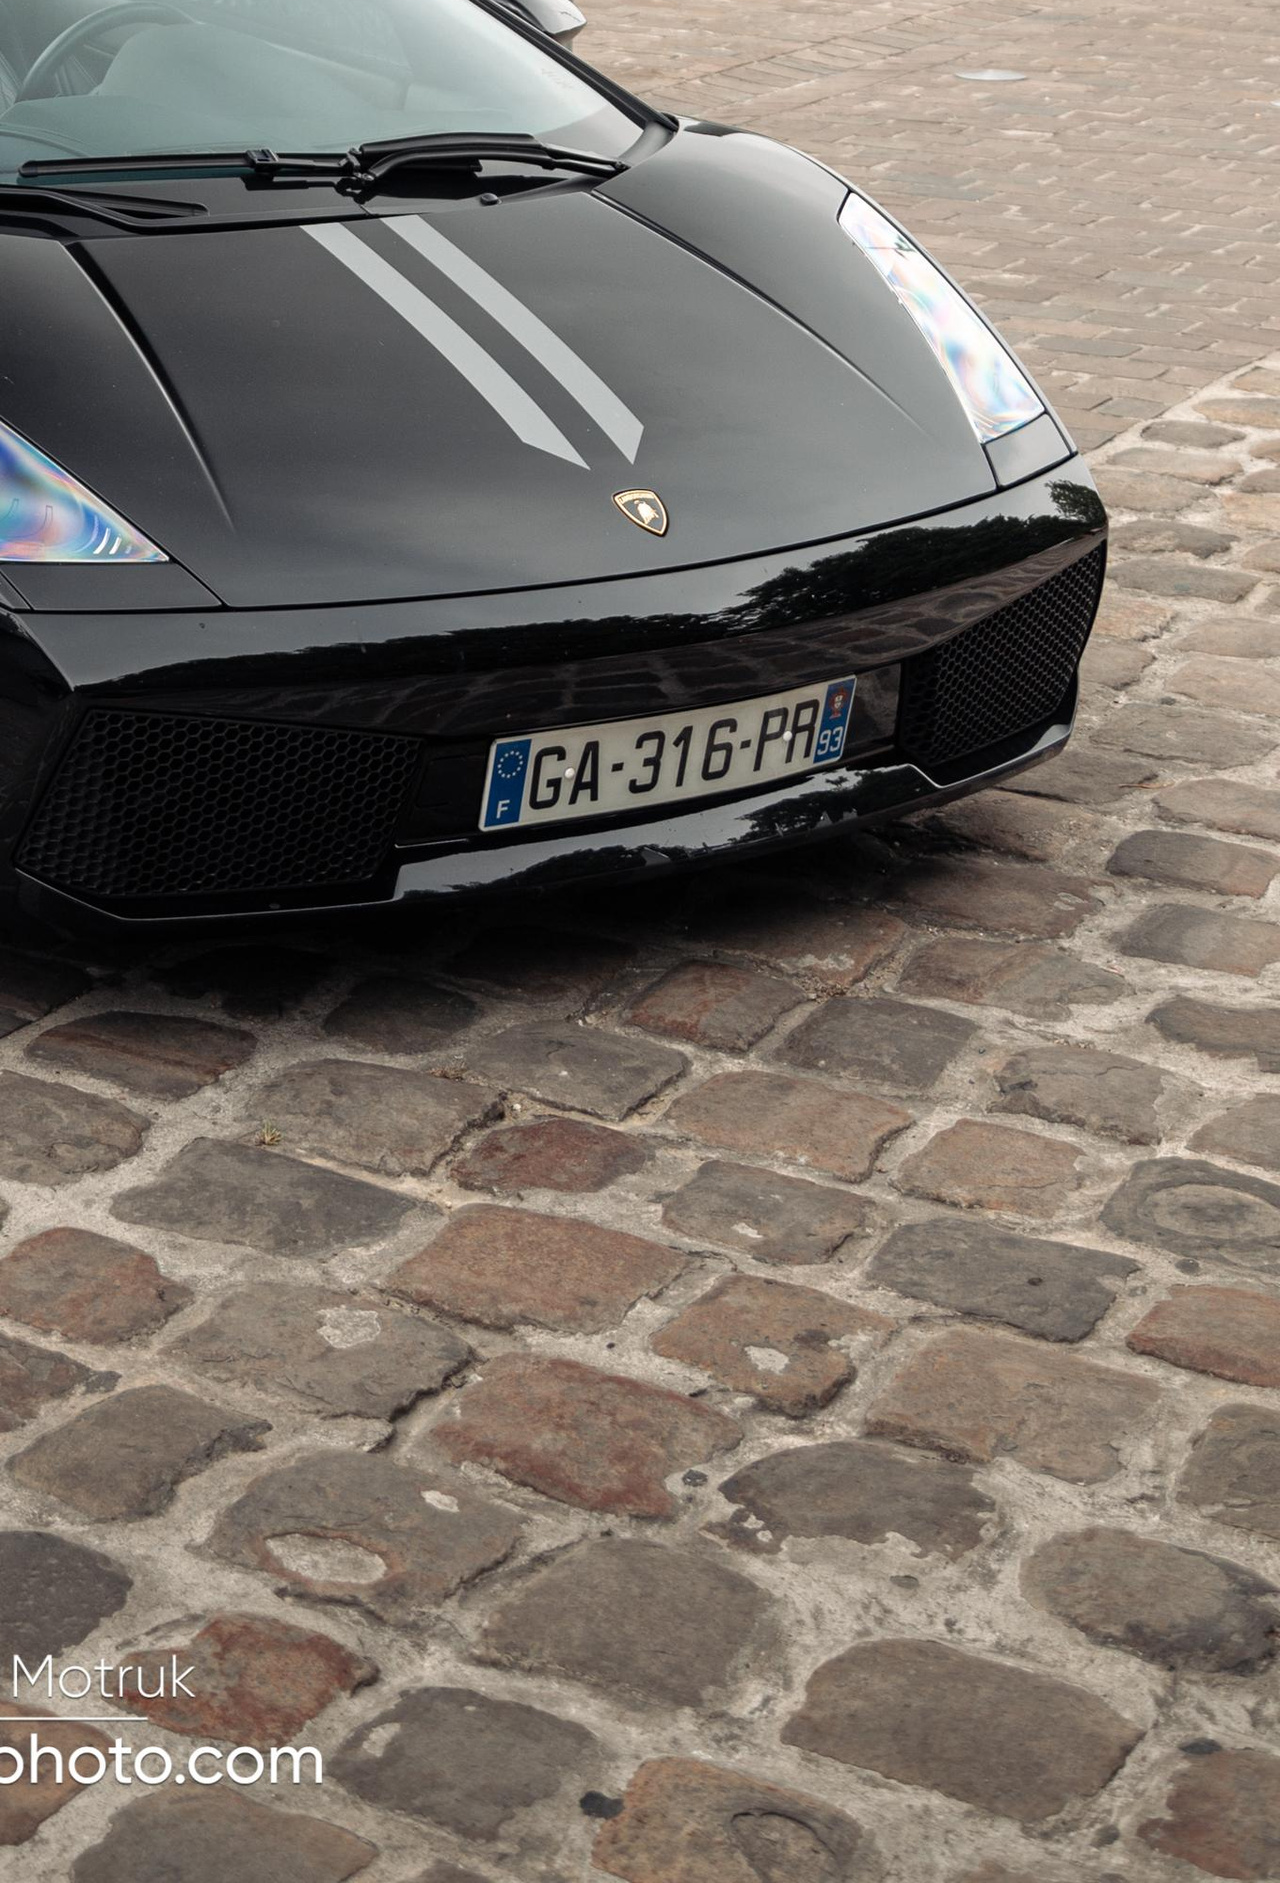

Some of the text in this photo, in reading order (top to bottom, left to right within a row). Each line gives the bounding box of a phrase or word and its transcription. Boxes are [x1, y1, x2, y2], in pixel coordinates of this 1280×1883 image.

[528, 698, 820, 810] GA-316-PR
[816, 725, 844, 756] 93
[496, 799, 510, 819] F
